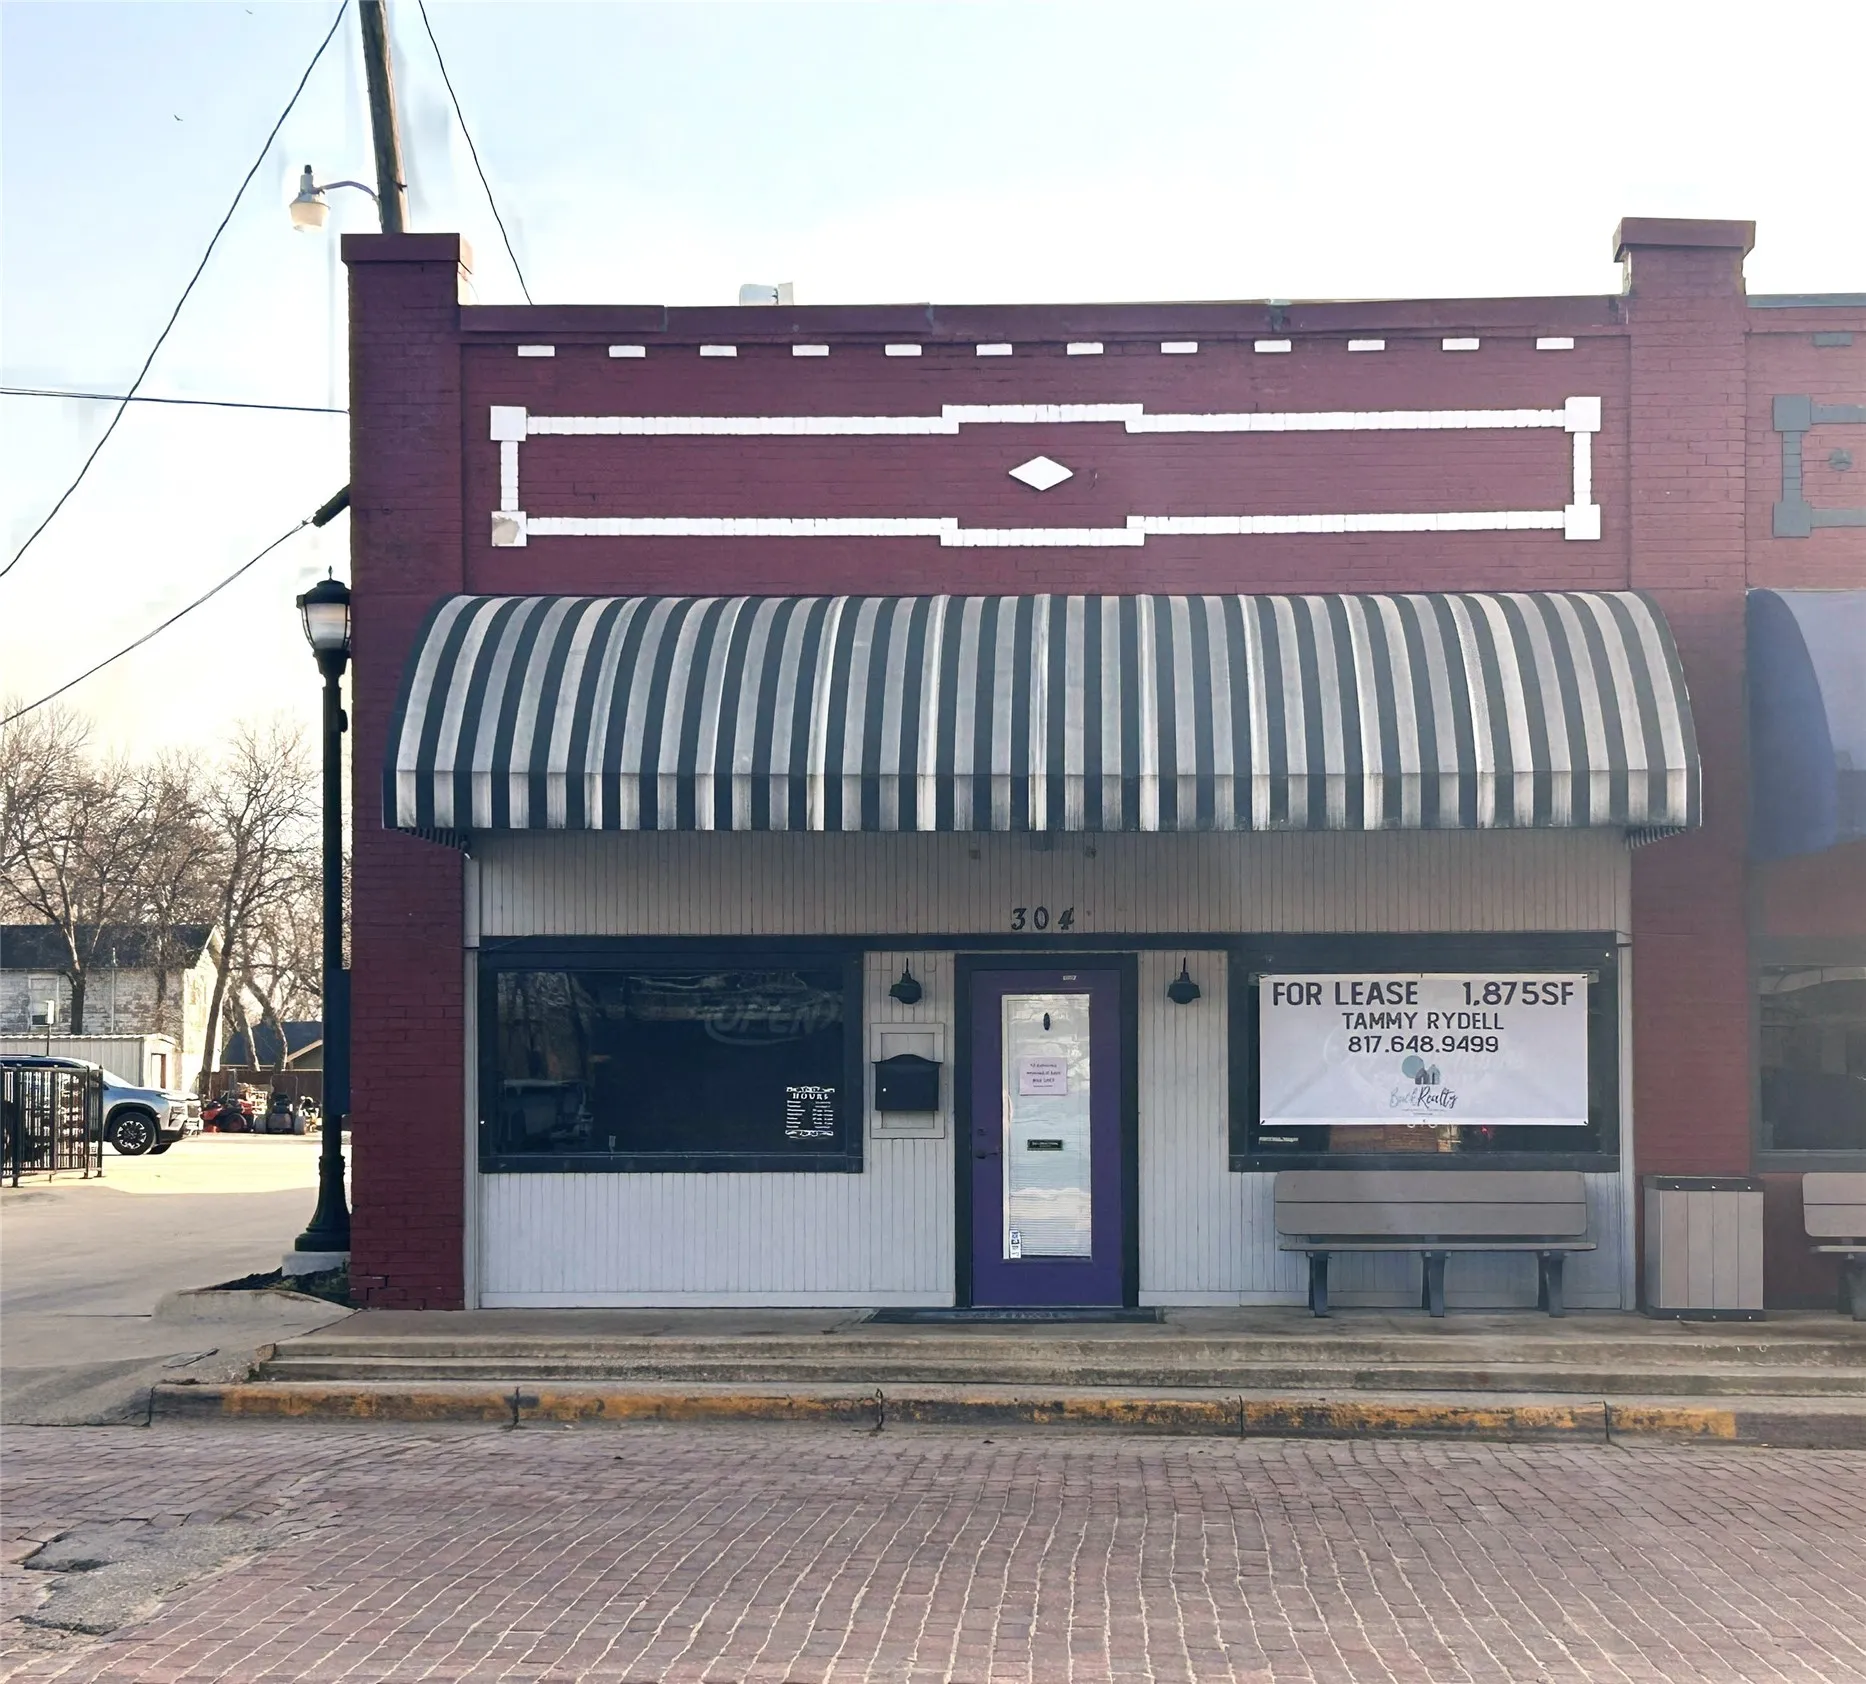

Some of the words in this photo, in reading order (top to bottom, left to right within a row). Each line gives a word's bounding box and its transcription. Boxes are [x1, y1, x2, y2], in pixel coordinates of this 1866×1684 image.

[1011, 905, 1075, 931] 304
[1273, 981, 1322, 1006] FOR
[1334, 981, 1418, 1006] LEASE
[1462, 981, 1574, 1006] 1,875SF
[1341, 1011, 1418, 1030] TAMMY
[1427, 1011, 1504, 1030] RYDELL
[1348, 1035, 1499, 1053] 817.648.9499
